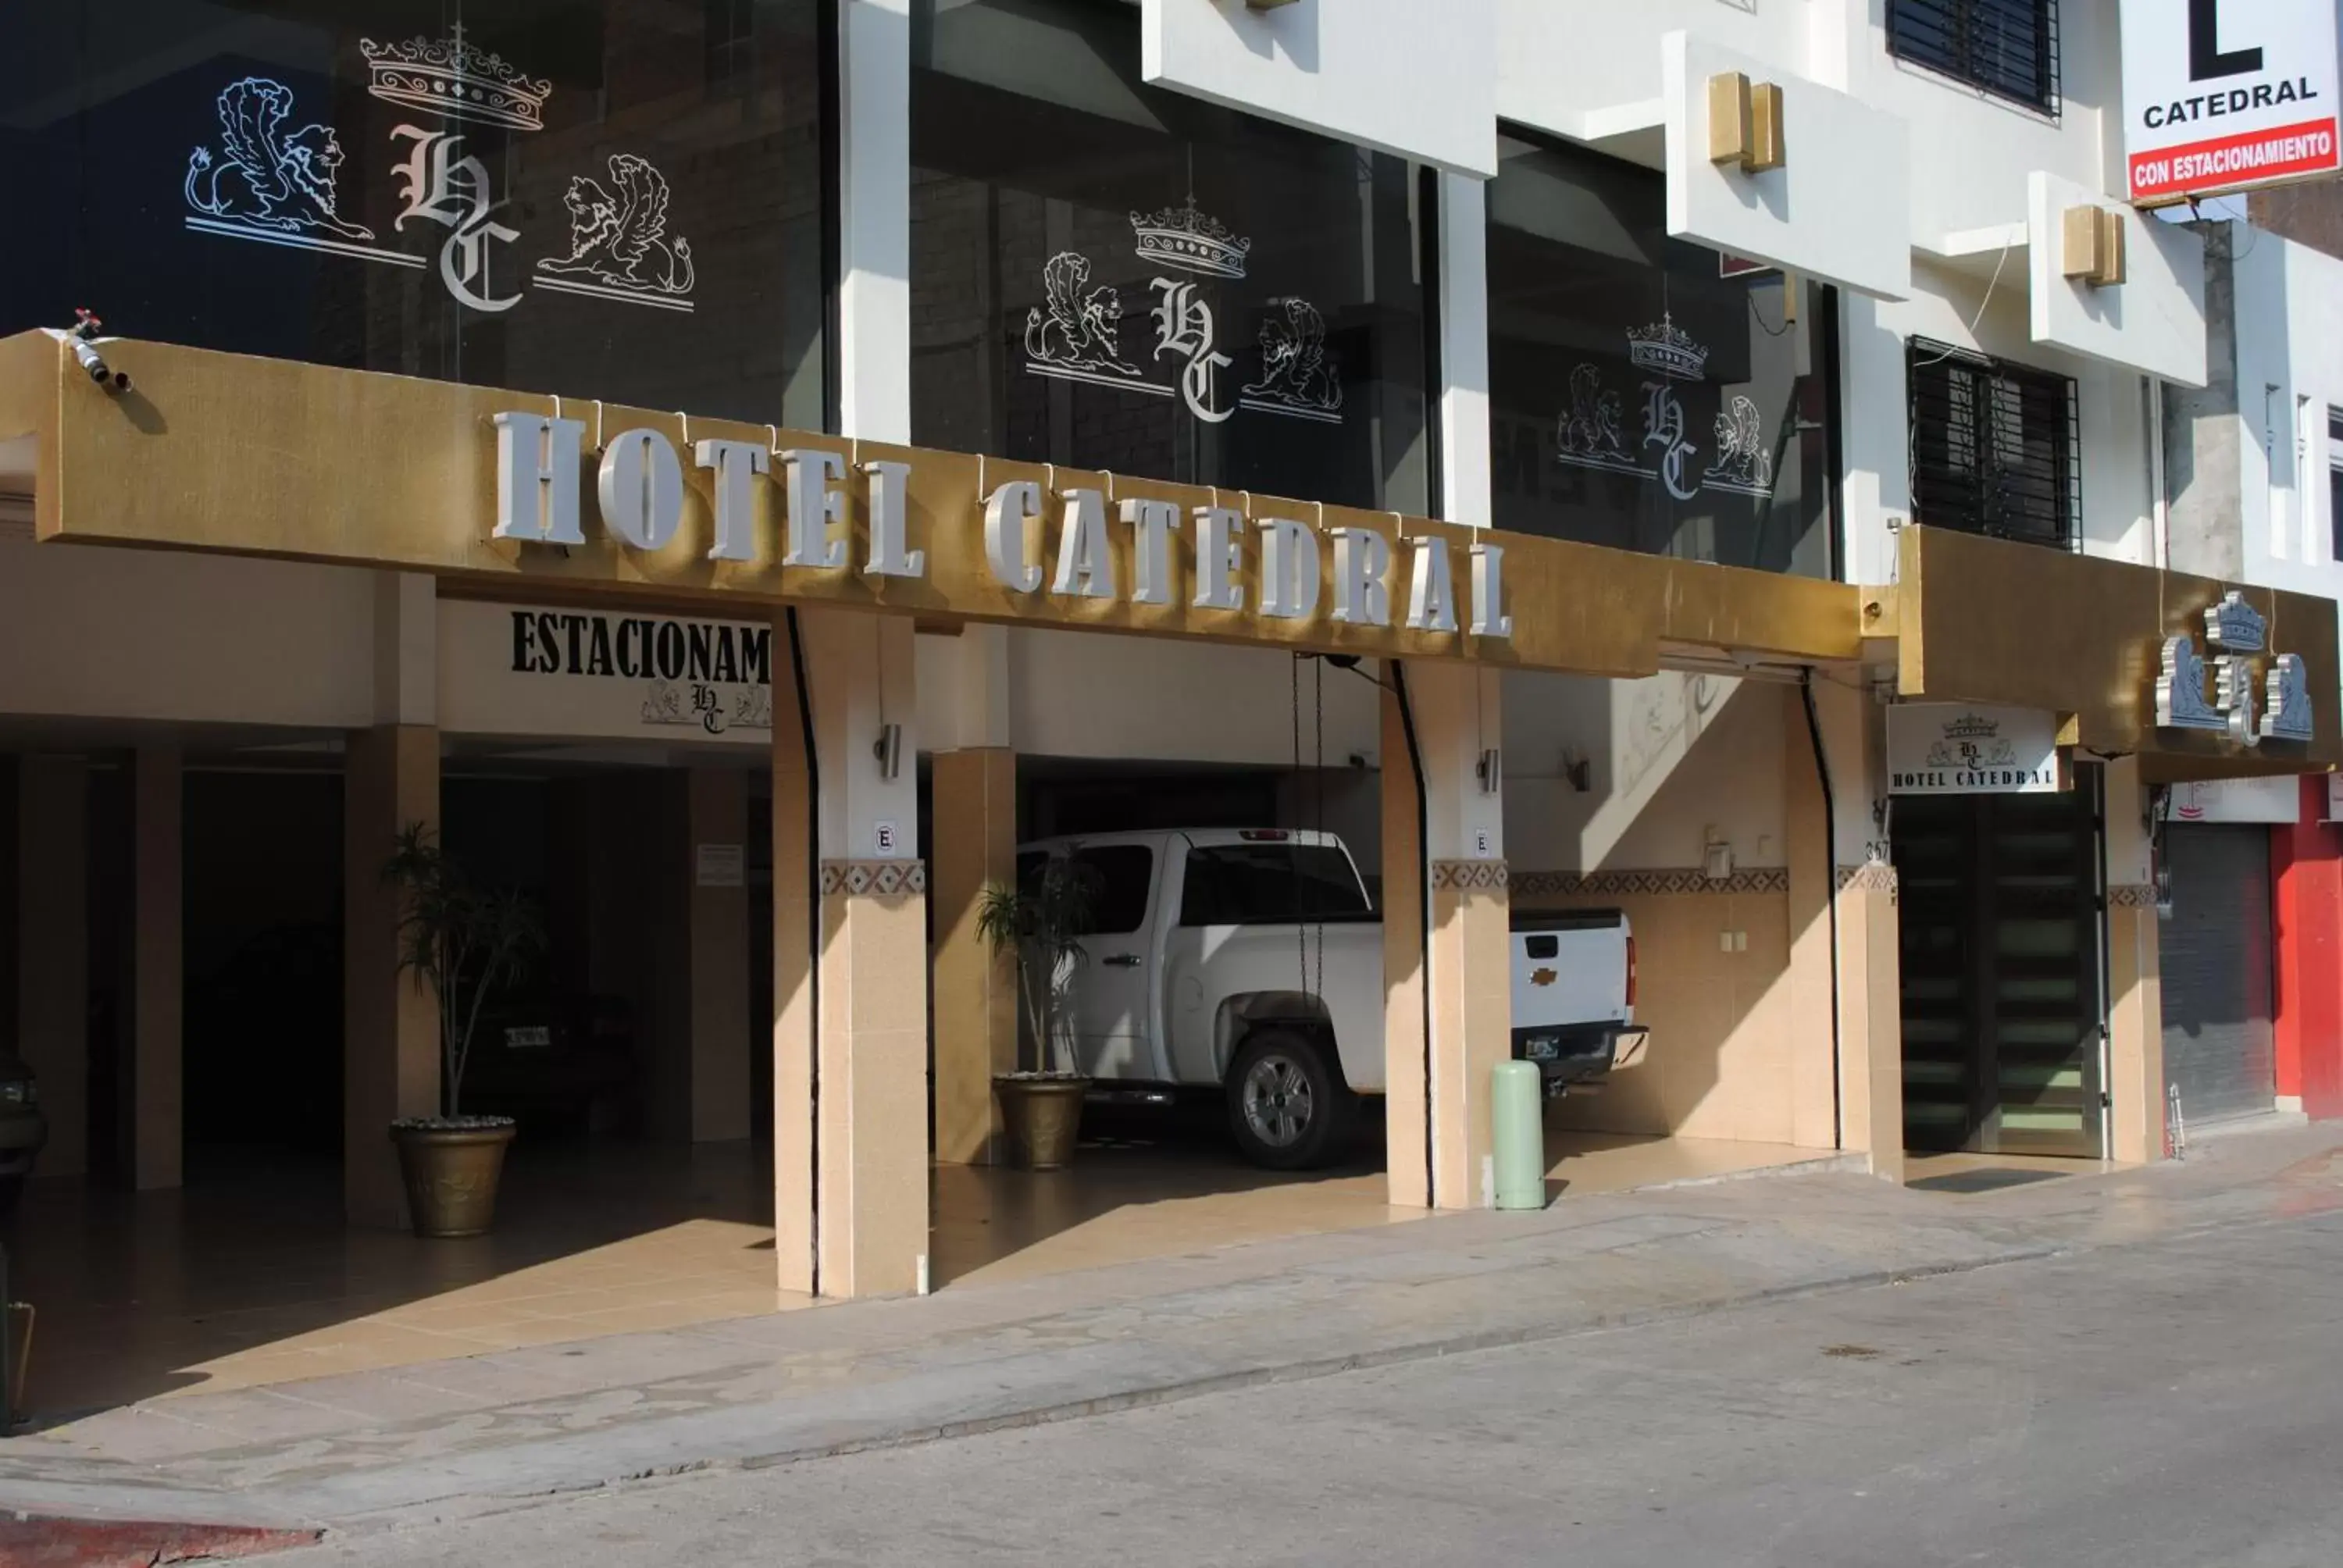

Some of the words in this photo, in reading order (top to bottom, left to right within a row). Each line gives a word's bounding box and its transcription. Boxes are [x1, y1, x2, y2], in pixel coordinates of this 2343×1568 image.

[2188, 0, 2263, 82] L
[2143, 77, 2318, 129] CATEDRAL
[2134, 159, 2170, 187] CON
[2174, 131, 2331, 180] ESTACIONAMIENTO
[492, 411, 925, 578] HOTEL
[984, 480, 1512, 637] CATEDRAL
[511, 611, 771, 684] ESTACIONAM
[1893, 772, 1946, 788] HOTEL
[1956, 770, 2052, 786] CATEDRAL
